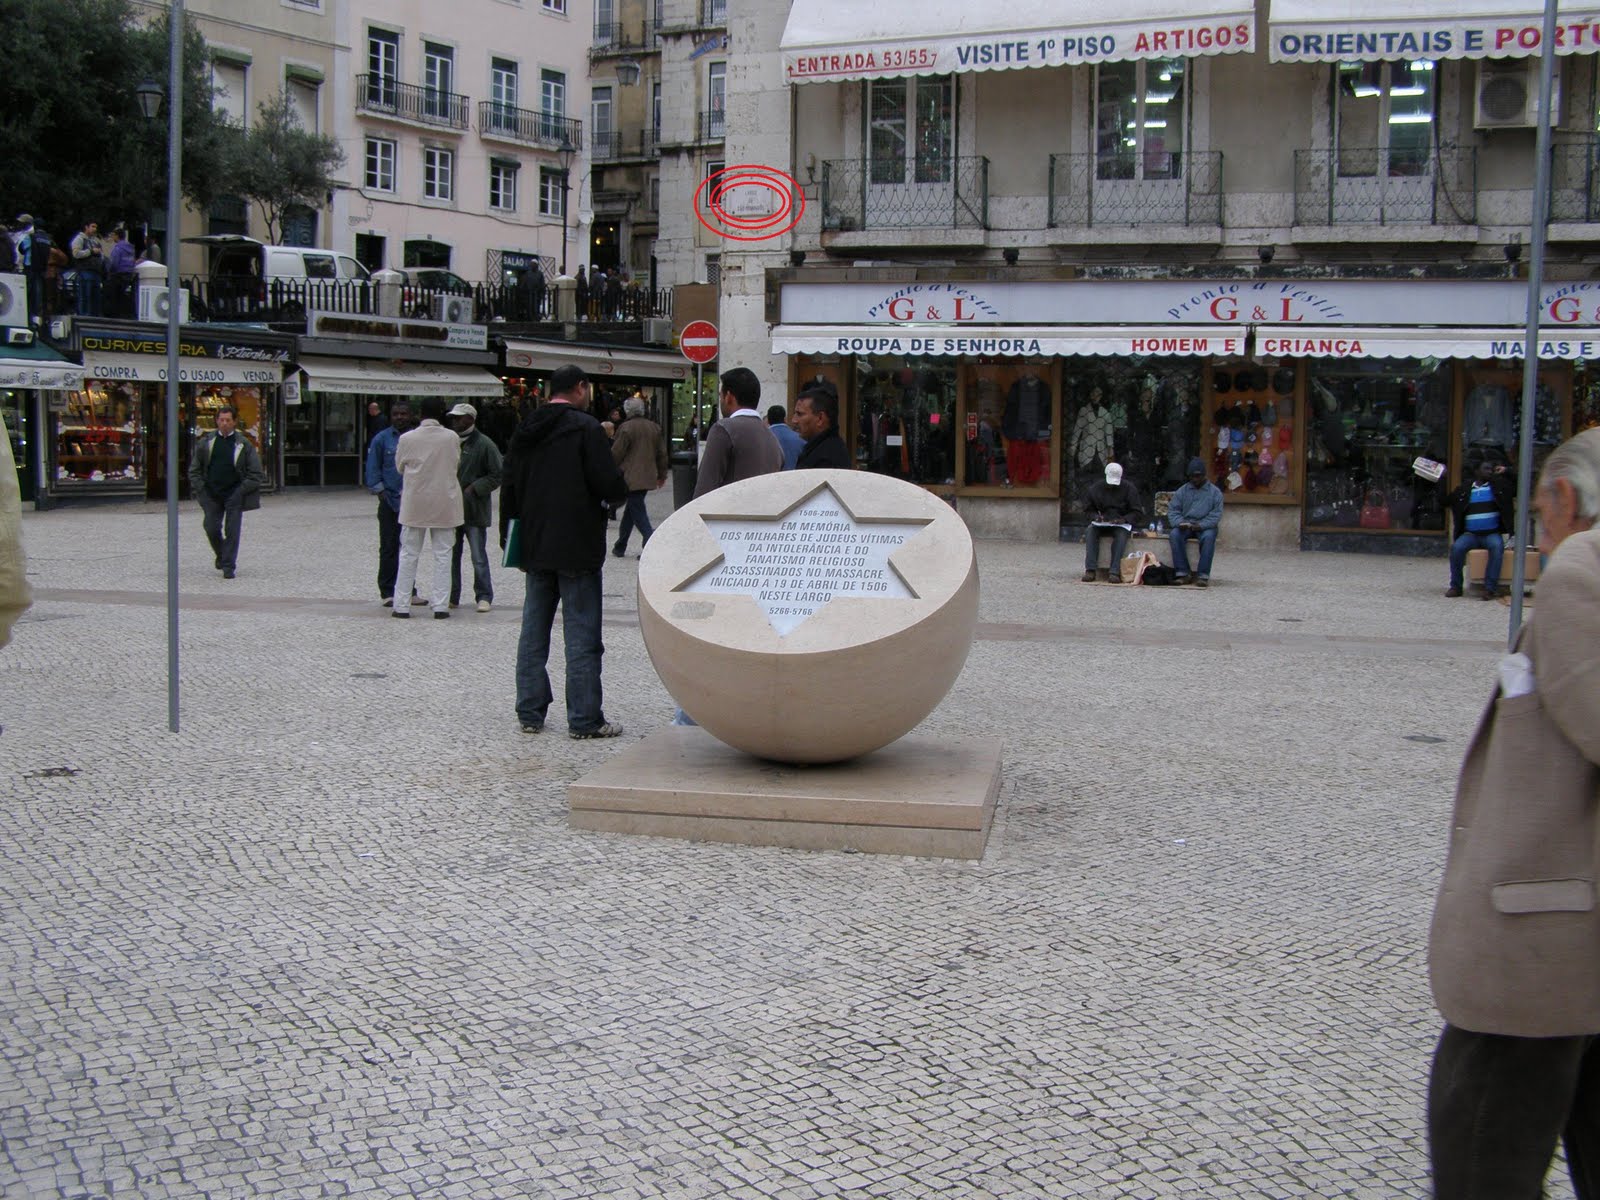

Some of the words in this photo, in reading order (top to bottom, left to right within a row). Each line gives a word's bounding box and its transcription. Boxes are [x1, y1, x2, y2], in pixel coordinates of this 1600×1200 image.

[797, 52, 876, 73] ENTRADA
[883, 48, 928, 67] 53/55
[956, 41, 1029, 65] VISITE
[1063, 35, 1116, 57] PISO
[1134, 24, 1250, 53] ARTIGOS
[1279, 30, 1452, 55] ORIENTAIS
[1464, 30, 1483, 51] E
[888, 297, 916, 321] G
[926, 305, 942, 320] &
[953, 297, 976, 321] L
[1210, 297, 1239, 321] G
[1252, 305, 1268, 321] &
[1280, 297, 1303, 321] L
[1549, 297, 1582, 323] G
[85, 338, 207, 356] OURIVESRIA
[837, 338, 902, 351] ROUPA
[910, 338, 935, 352] DE
[944, 338, 1041, 352] SENHORA
[1131, 338, 1208, 352] HOMEM
[1224, 338, 1236, 352] E
[1264, 339, 1363, 358] CRIANÇA
[1491, 341, 1571, 355] MAAS
[1580, 342, 1592, 355] E
[94, 366, 139, 379] COMPRA
[191, 370, 225, 382] USADO
[243, 371, 275, 382] VENDA
[781, 521, 797, 531] EM
[799, 521, 850, 532] MEMÓRIA
[720, 531, 741, 541] DOS
[744, 531, 797, 542] MILHARES
[799, 533, 814, 542] DE
[815, 533, 857, 543] JUDEUS
[860, 533, 904, 545] VÍTIMAS
[748, 543, 762, 553] DA
[766, 543, 841, 554] INTOLERÂNCIA
[844, 545, 851, 555] E
[854, 545, 869, 555] DO
[745, 554, 806, 565] FANATISMO
[809, 556, 865, 567] RELIGIOSO
[720, 565, 802, 577] ASSASSINADOS
[805, 567, 821, 577] NO
[824, 568, 884, 579] MASSACRE
[710, 577, 759, 588] INICIADO
[762, 578, 769, 588] A
[774, 579, 787, 589] 19
[790, 579, 804, 589] DE
[806, 580, 839, 590] ABRIL
[842, 580, 857, 590] DE
[860, 581, 888, 592] 1506
[759, 590, 792, 601] NESTE
[795, 592, 832, 603] LARGO
[769, 606, 813, 616] 5266-5766
